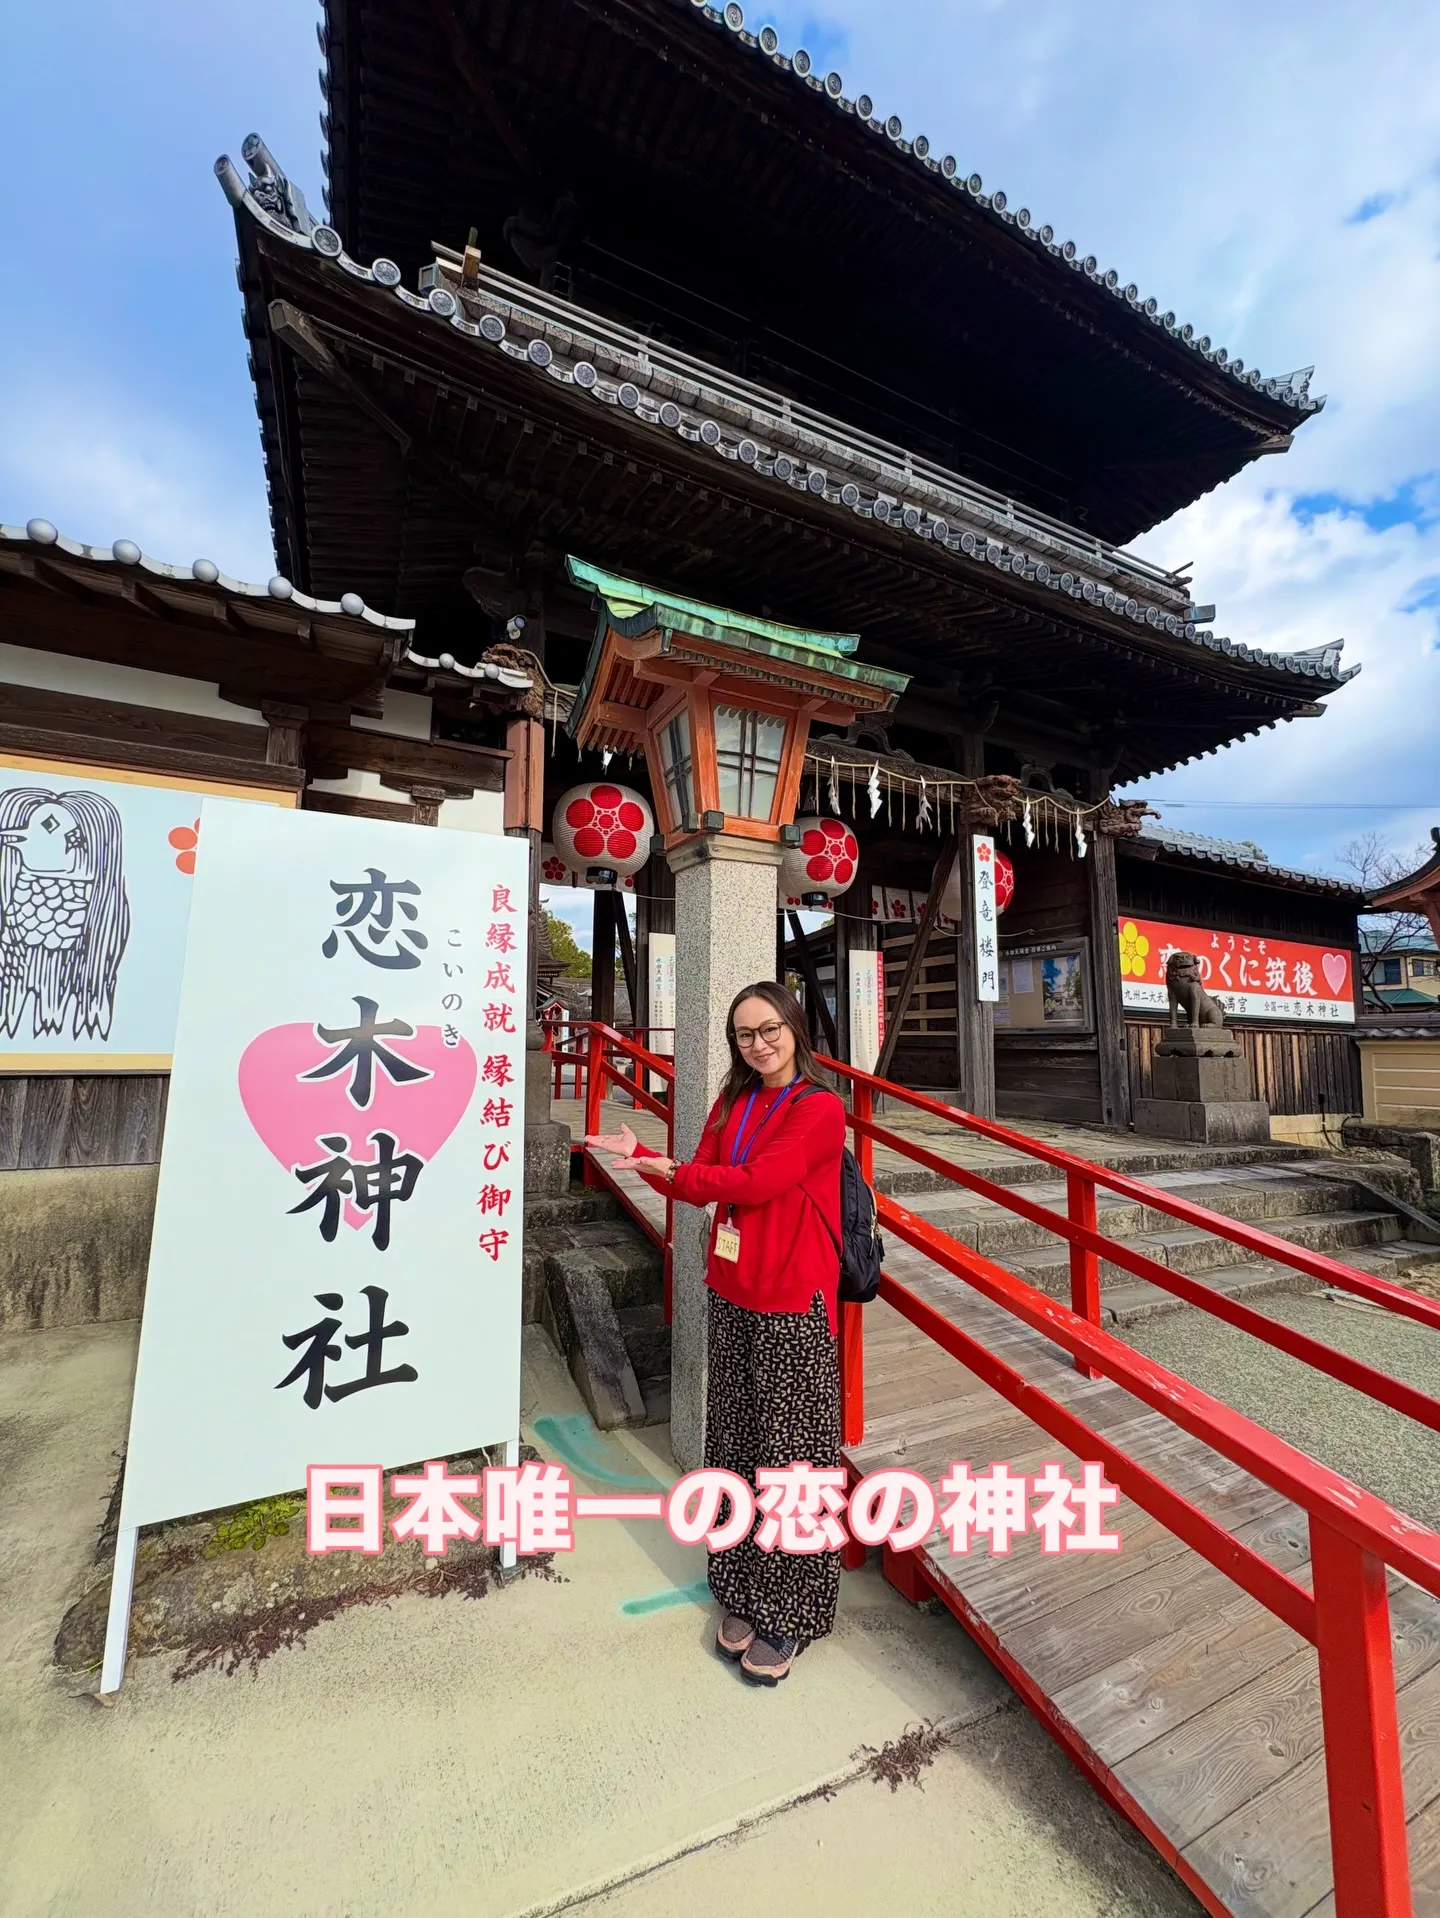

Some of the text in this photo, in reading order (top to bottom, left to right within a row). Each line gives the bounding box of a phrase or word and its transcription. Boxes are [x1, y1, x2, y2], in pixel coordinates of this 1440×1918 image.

[441, 928, 464, 1048] こいのき
[978, 870, 995, 990] 登竜楼門
[1211, 933, 1267, 955] ようこそ
[1124, 989, 1169, 1004] 九州二大天
[1293, 1000, 1339, 1018] 恋木神社
[476, 884, 518, 1261] 良縁成就 縁結び御守
[275, 868, 434, 1410] 恋木神社
[717, 1236, 738, 1256] STAFF
